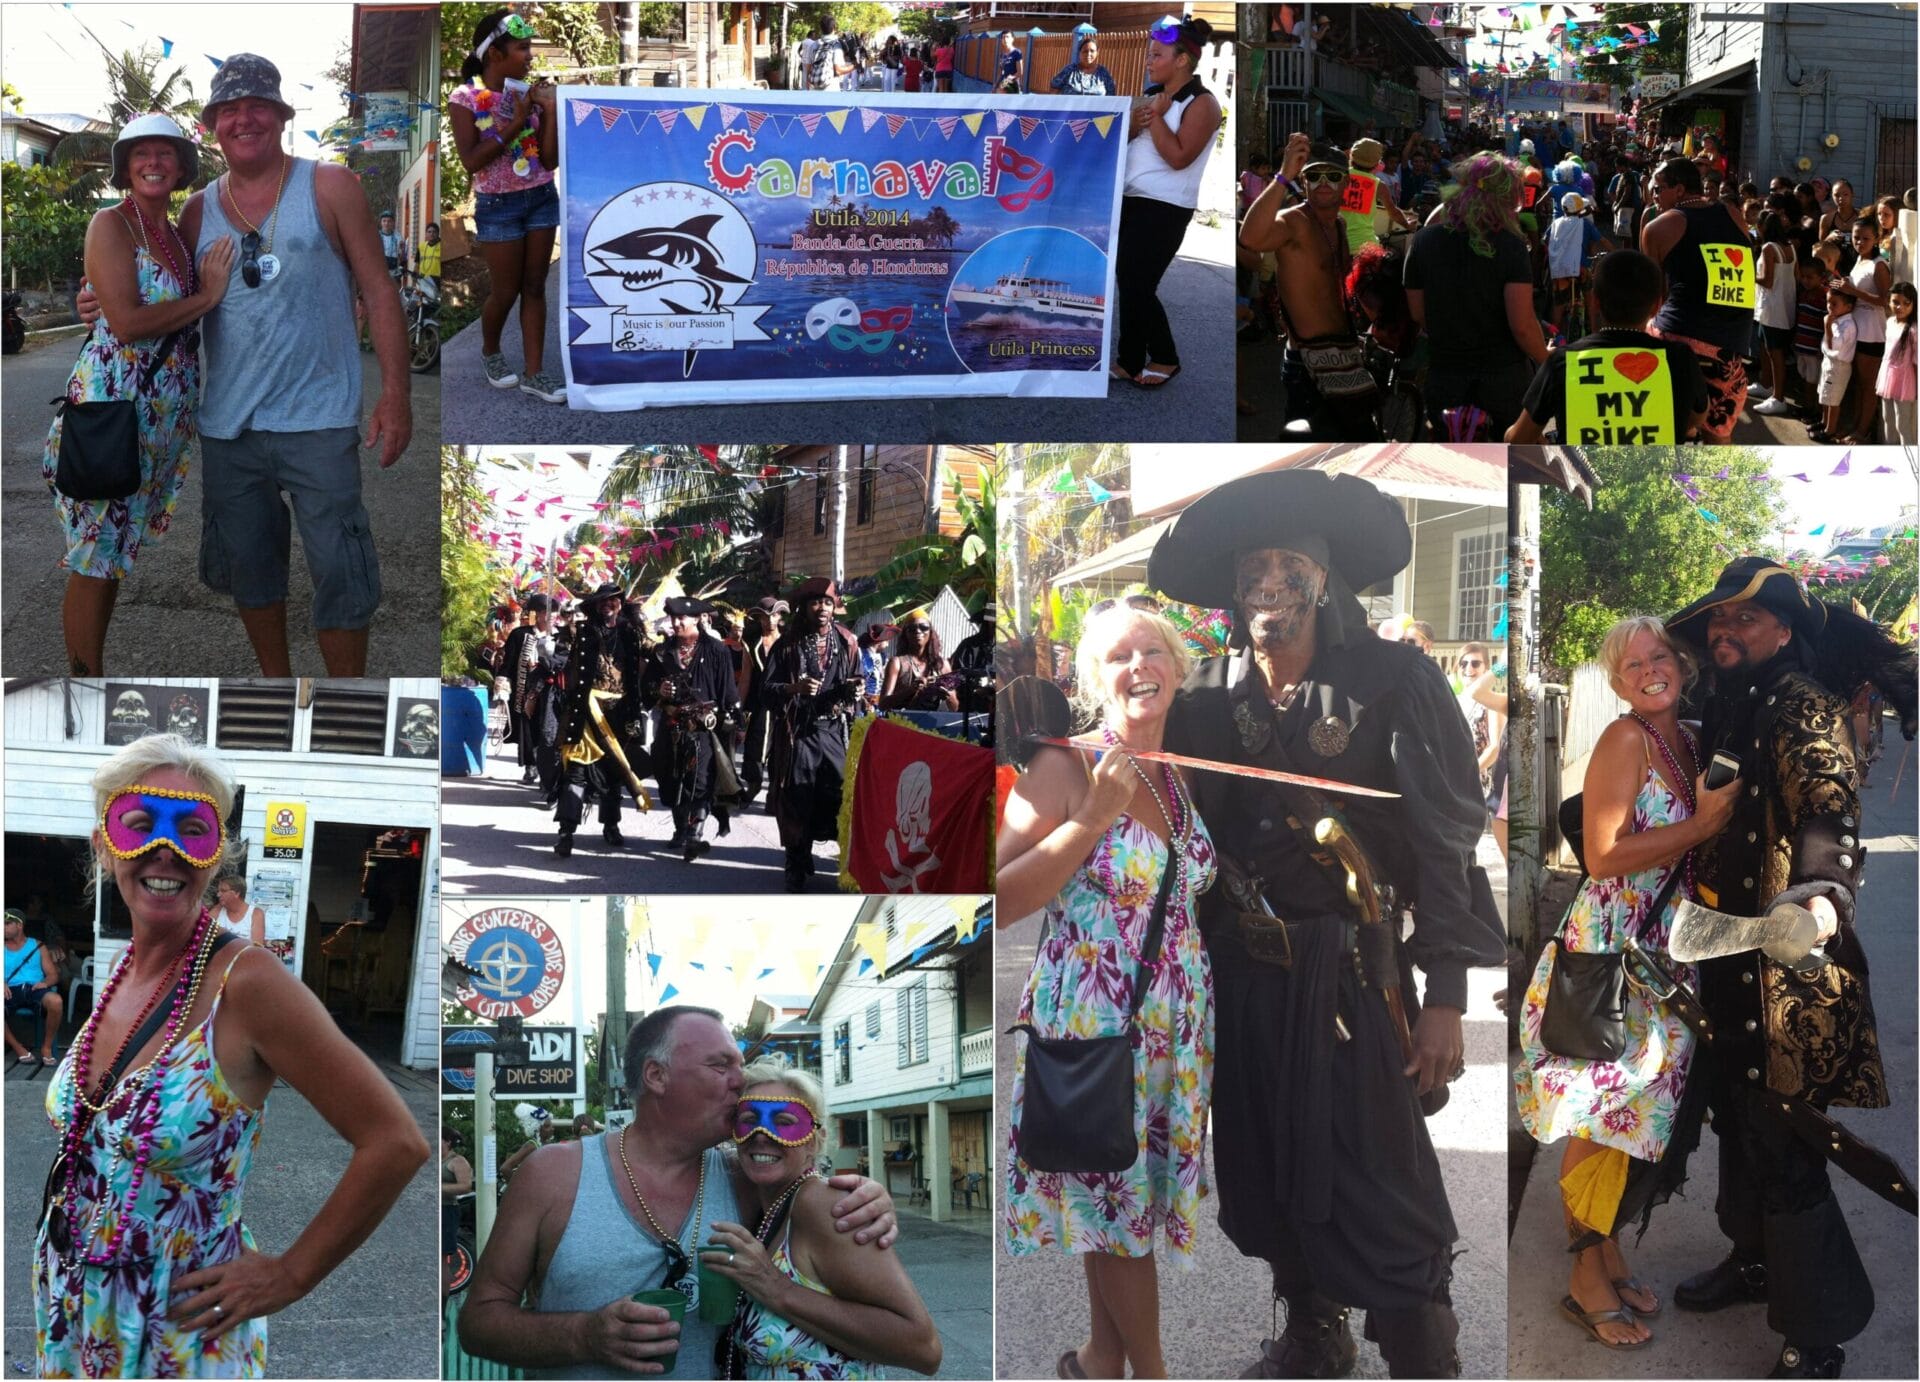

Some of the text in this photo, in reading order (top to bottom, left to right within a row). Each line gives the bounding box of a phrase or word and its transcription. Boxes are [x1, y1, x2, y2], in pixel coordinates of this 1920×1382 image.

[704, 128, 1005, 200] Carnaval
[815, 209, 910, 227] Utila 2014
[792, 233, 925, 251] Banda de Guerra
[1706, 248, 1722, 263] I
[765, 258, 948, 281] Républica de Honduras
[1719, 267, 1744, 282] MY
[622, 318, 652, 329] Music
[655, 318, 663, 329] is
[689, 318, 726, 329] Passion
[989, 341, 1096, 357] Utila Princess
[1578, 357, 1604, 385] I
[1596, 390, 1650, 418] MY
[274, 848, 297, 858] 35.00
[473, 909, 547, 939] GUNTER'S
[540, 936, 563, 974] DIVE
[529, 975, 560, 1009] SHOP
[522, 1032, 572, 1062] ADI
[507, 1068, 574, 1085] DIVE SHOP
